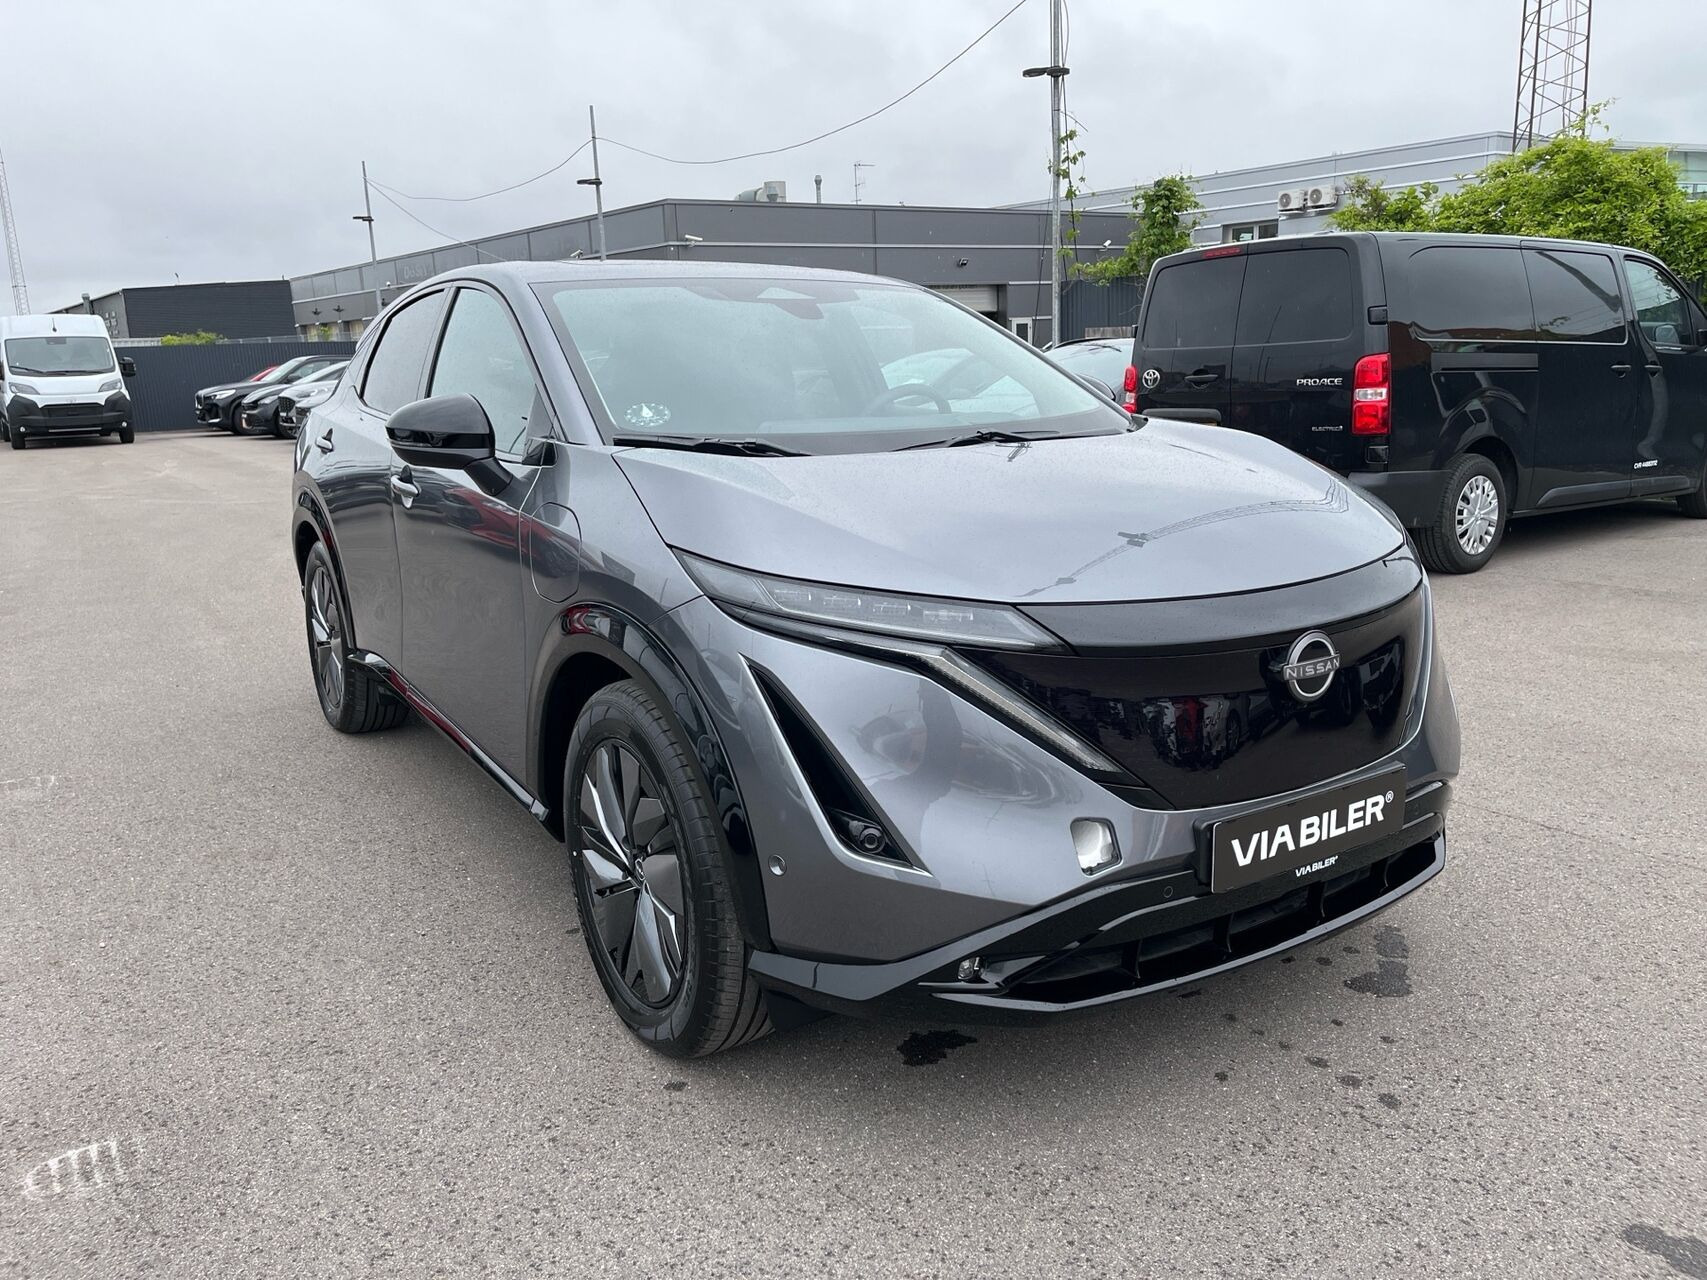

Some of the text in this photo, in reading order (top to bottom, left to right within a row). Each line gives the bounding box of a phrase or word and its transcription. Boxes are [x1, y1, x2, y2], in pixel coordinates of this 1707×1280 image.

[1296, 377, 1343, 386] PROACE
[1286, 656, 1340, 679] NISSAN
[1231, 824, 1296, 867] VIA
[1295, 864, 1312, 877] VIA
